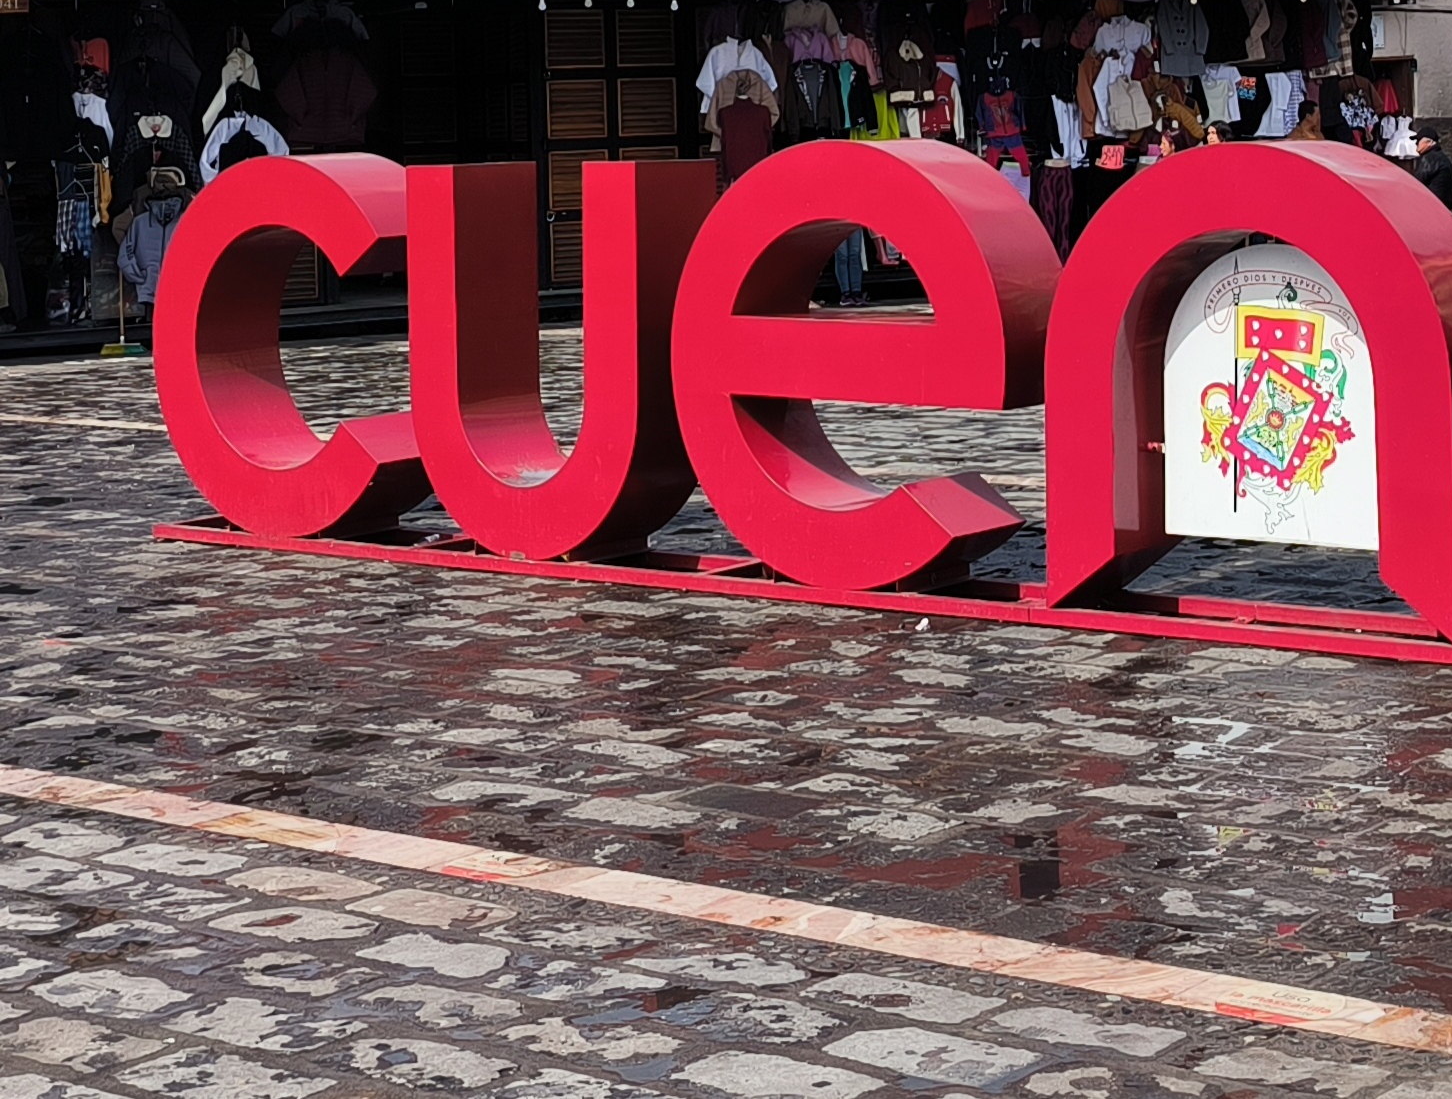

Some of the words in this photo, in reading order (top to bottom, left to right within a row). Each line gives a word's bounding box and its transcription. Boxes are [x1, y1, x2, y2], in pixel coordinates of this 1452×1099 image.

[1207, 277, 1239, 310] PRIMERO
[1243, 274, 1267, 283] DIOS
[1271, 274, 1277, 282] Y
